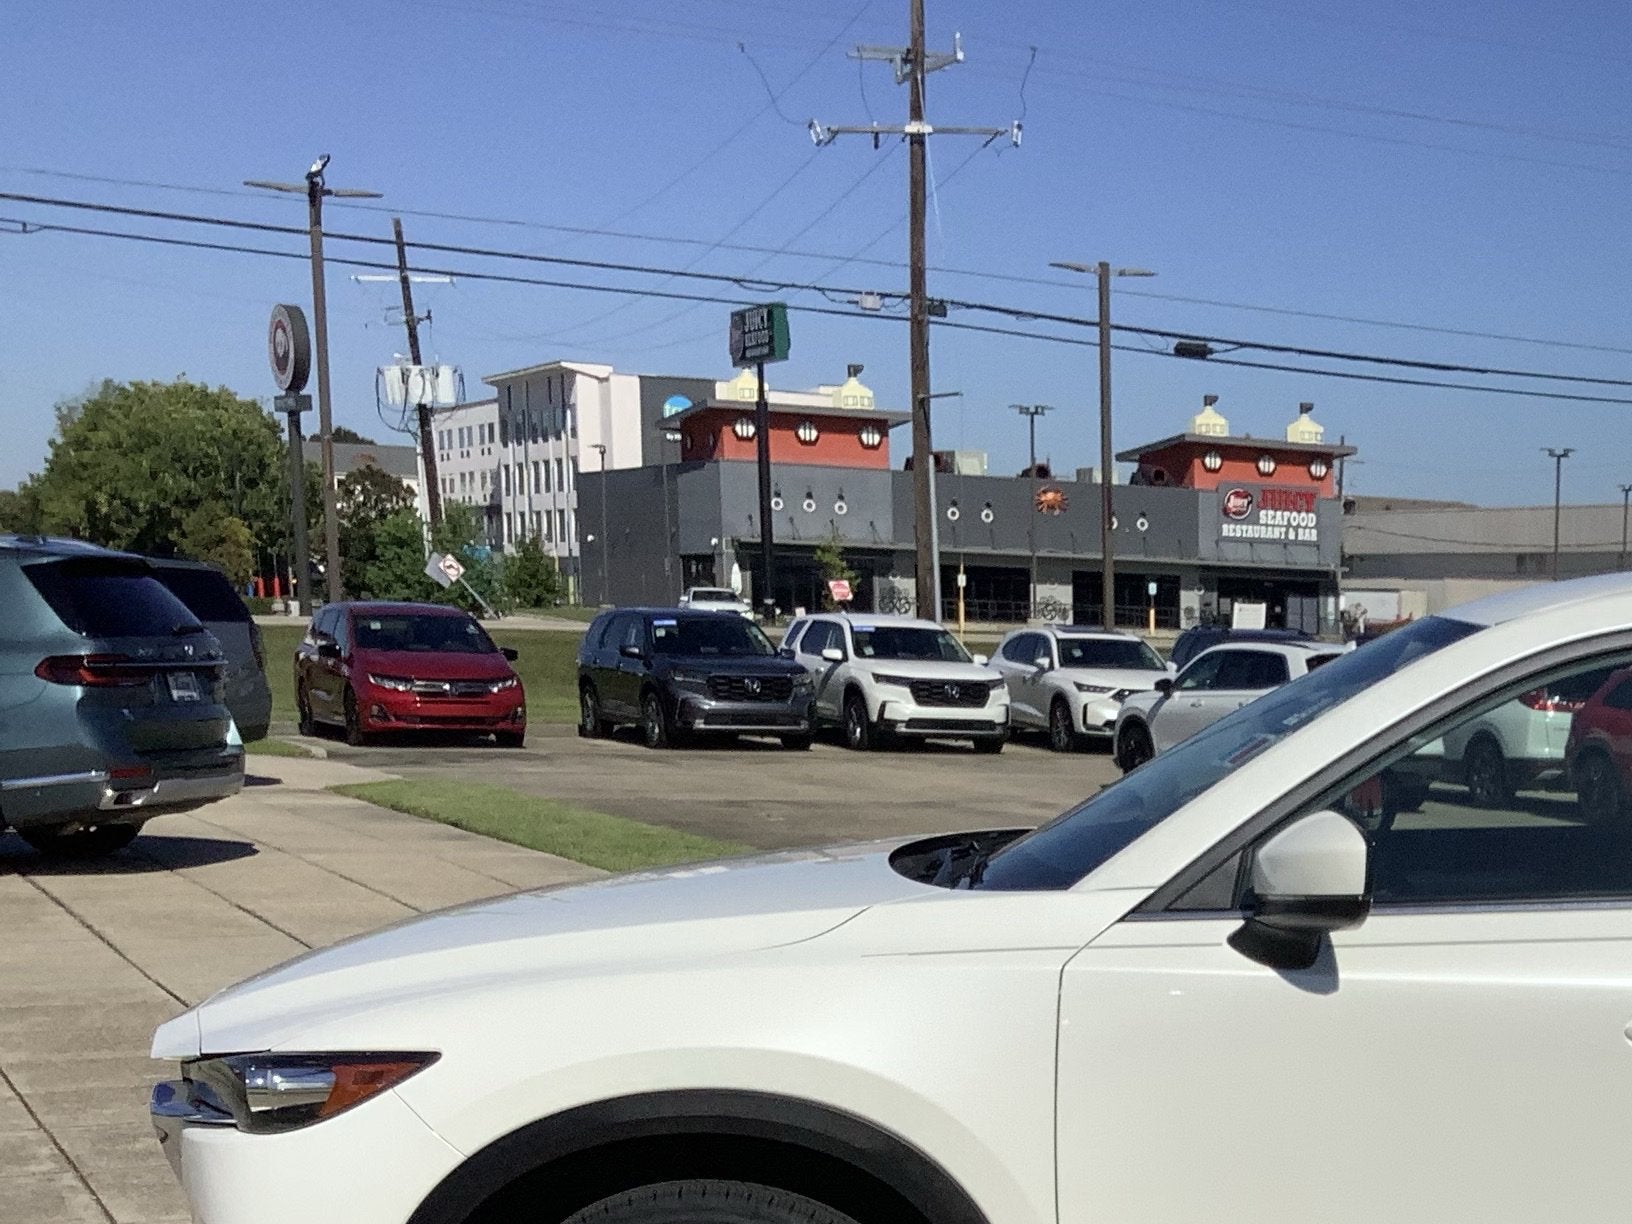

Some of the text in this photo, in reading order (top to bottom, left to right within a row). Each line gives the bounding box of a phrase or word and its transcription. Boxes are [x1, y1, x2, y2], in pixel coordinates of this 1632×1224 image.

[744, 308, 768, 333] JUICY
[1257, 489, 1317, 513] JUICY
[1259, 509, 1317, 527] SEAFOOD
[1222, 523, 1318, 541] RESTAURANT & BAR
